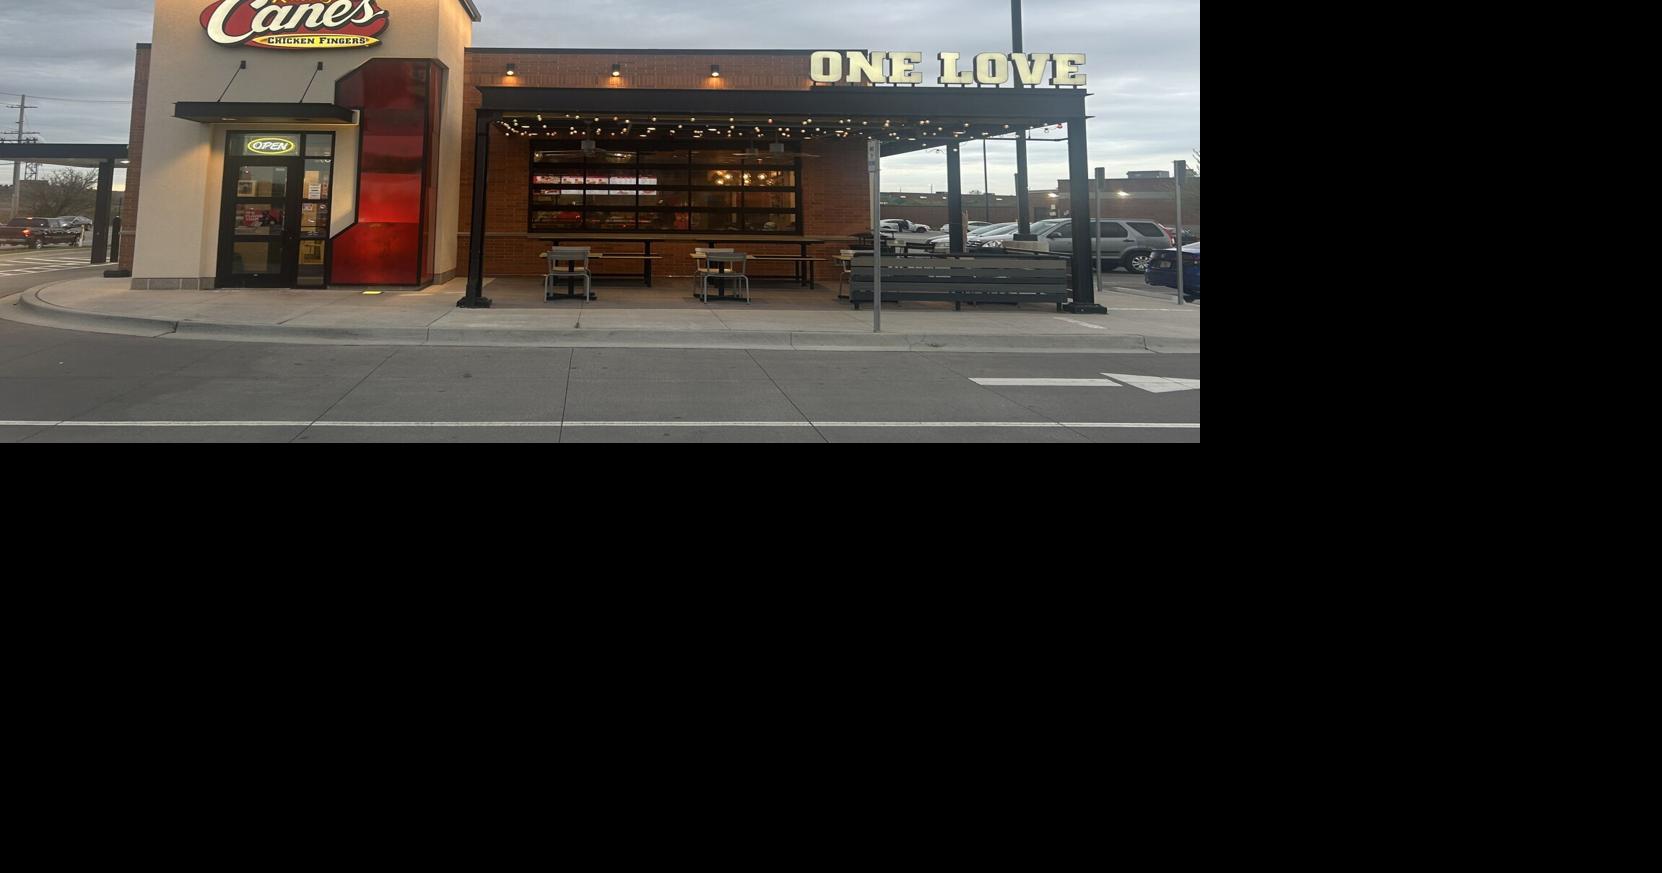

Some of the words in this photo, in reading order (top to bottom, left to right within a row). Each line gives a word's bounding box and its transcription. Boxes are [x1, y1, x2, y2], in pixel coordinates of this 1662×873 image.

[267, 36, 314, 45] CHICKEN
[319, 36, 367, 45] FINGERS
[810, 51, 922, 84] ONE
[937, 52, 1087, 85] LOVE
[252, 141, 289, 150] OPEN
